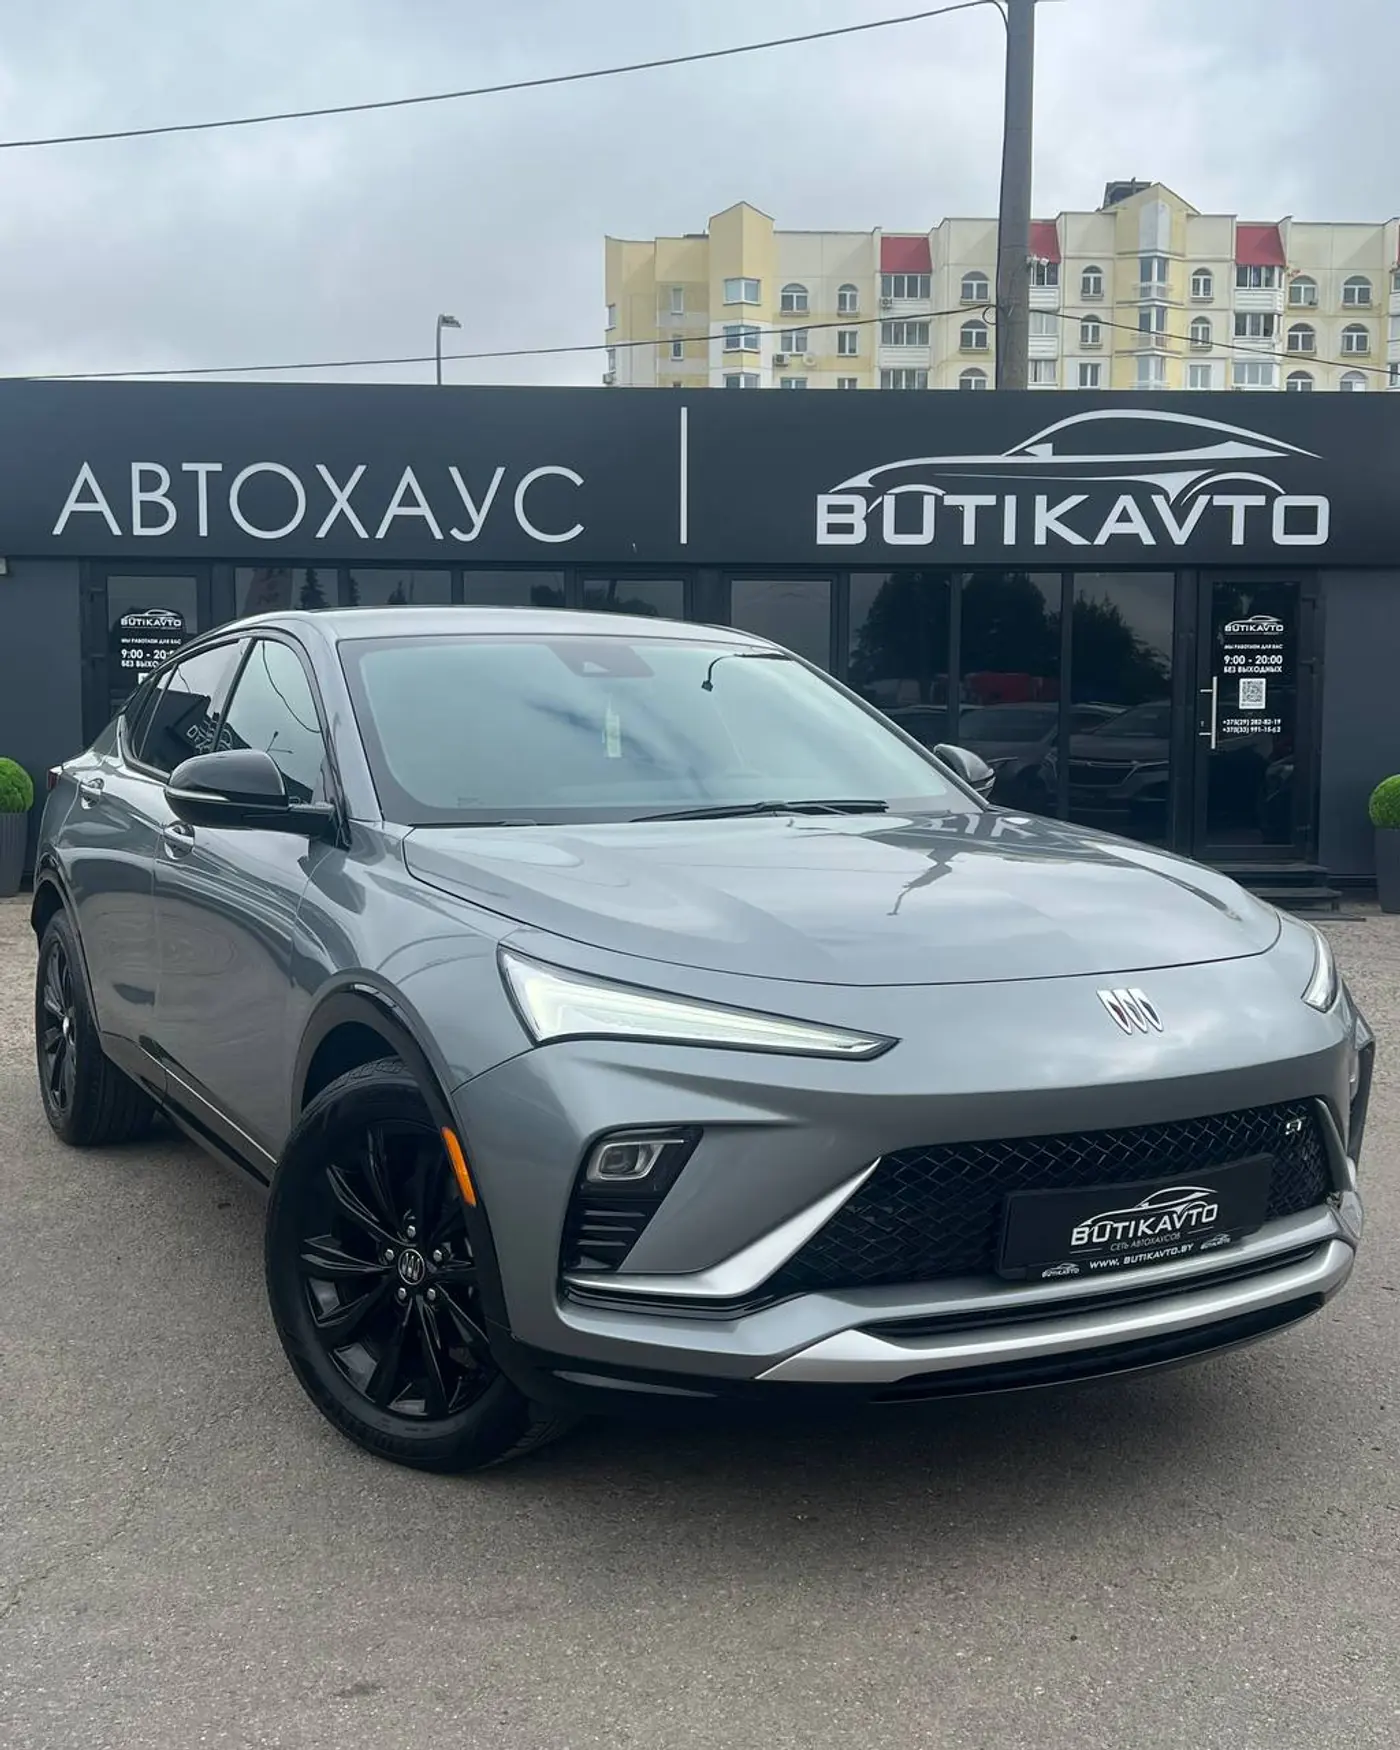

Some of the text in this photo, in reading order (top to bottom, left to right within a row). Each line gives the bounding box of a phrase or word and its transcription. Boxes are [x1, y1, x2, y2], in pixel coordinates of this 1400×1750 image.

[52, 461, 585, 544] АВТОХАУС
[815, 493, 1331, 546] BUTIKAVTO
[121, 617, 182, 627] BUTIKAVTO
[1224, 624, 1284, 632] BUTIKAVTO
[121, 648, 144, 659] 9:00
[1223, 655, 1246, 665] 9:00
[1255, 655, 1283, 665] 20:00
[1070, 1204, 1219, 1246] BUTIKAVTO
[1110, 1231, 1181, 1252] СЕТЬ АВТОХАУСОВ
[1089, 1243, 1194, 1269] WWW. BUTIKAVTO.BY
